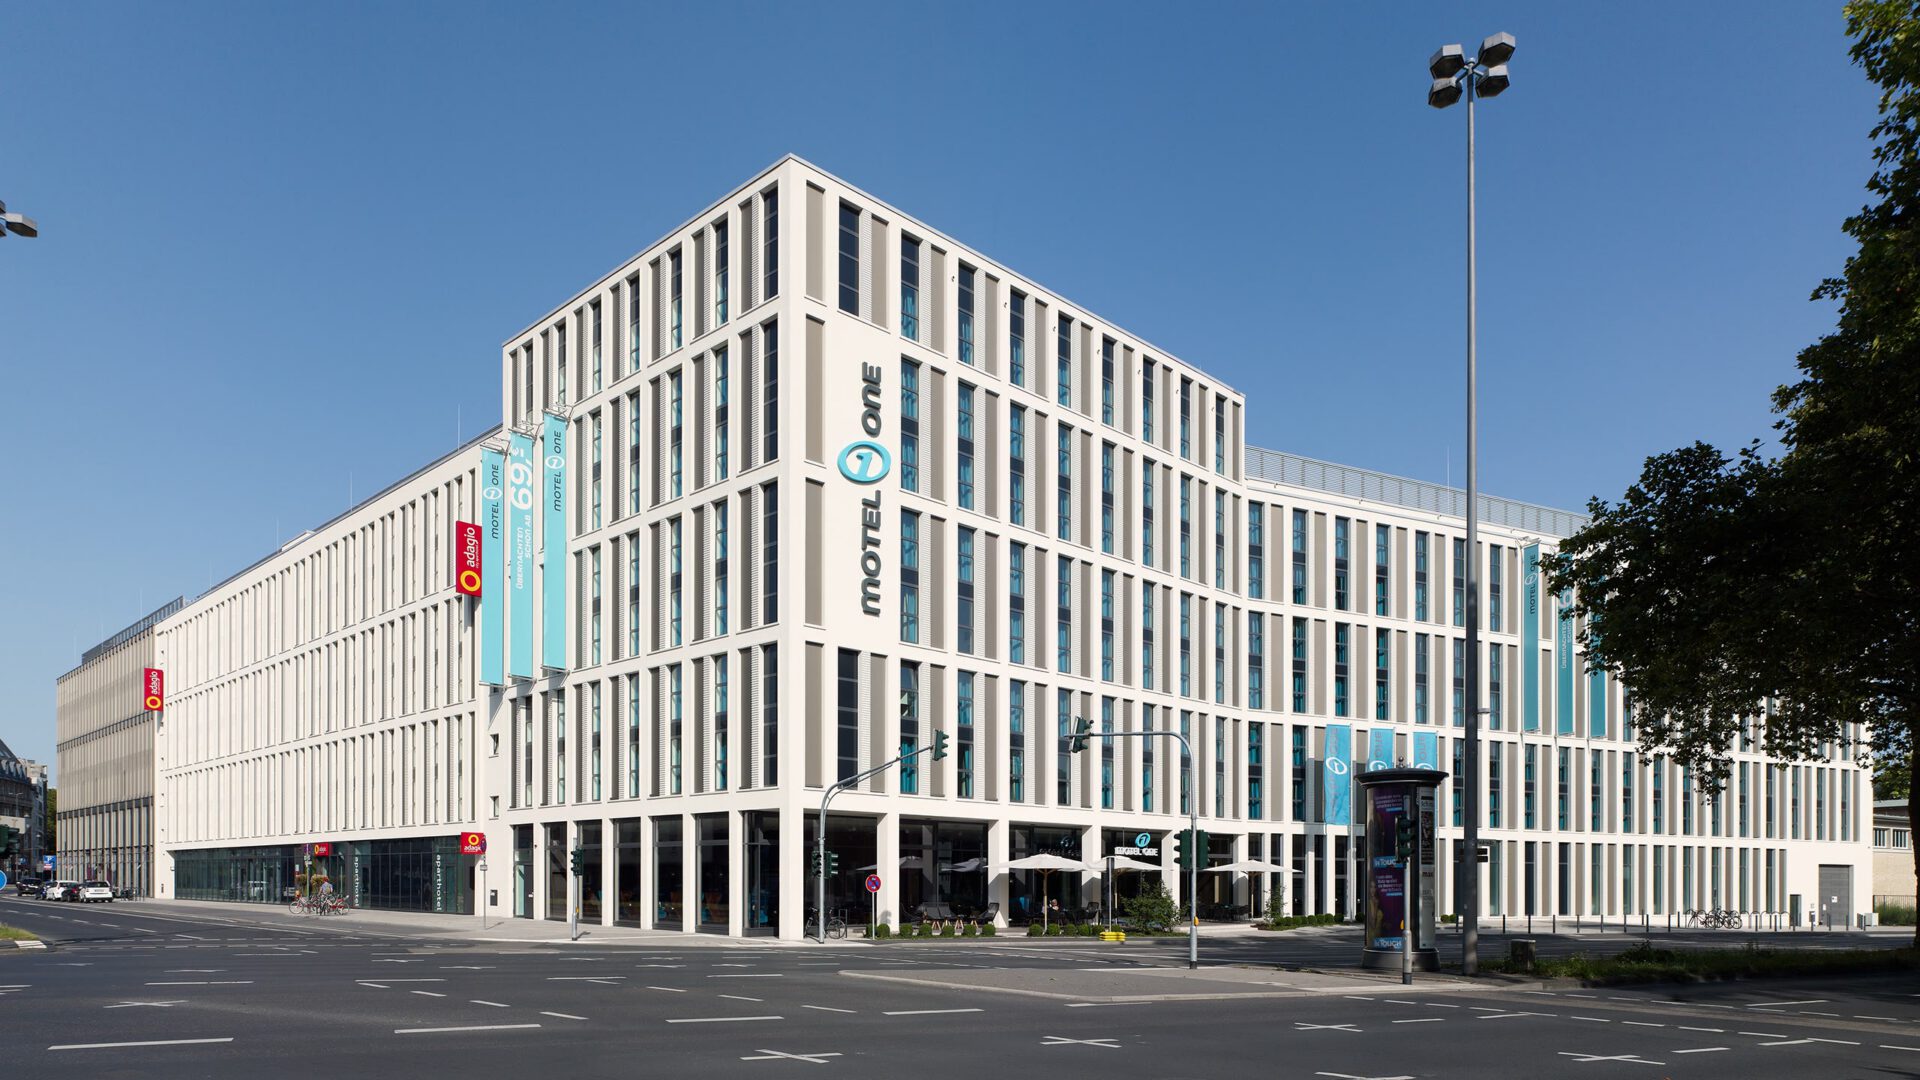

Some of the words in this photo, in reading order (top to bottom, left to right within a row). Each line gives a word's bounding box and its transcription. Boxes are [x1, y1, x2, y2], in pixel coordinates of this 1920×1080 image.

[861, 361, 882, 438] ONE
[491, 463, 499, 485] ONE
[491, 502, 499, 539] MOTEL
[463, 527, 478, 568] adagio
[860, 490, 882, 617] MOTEL
[149, 671, 160, 695] adagio
